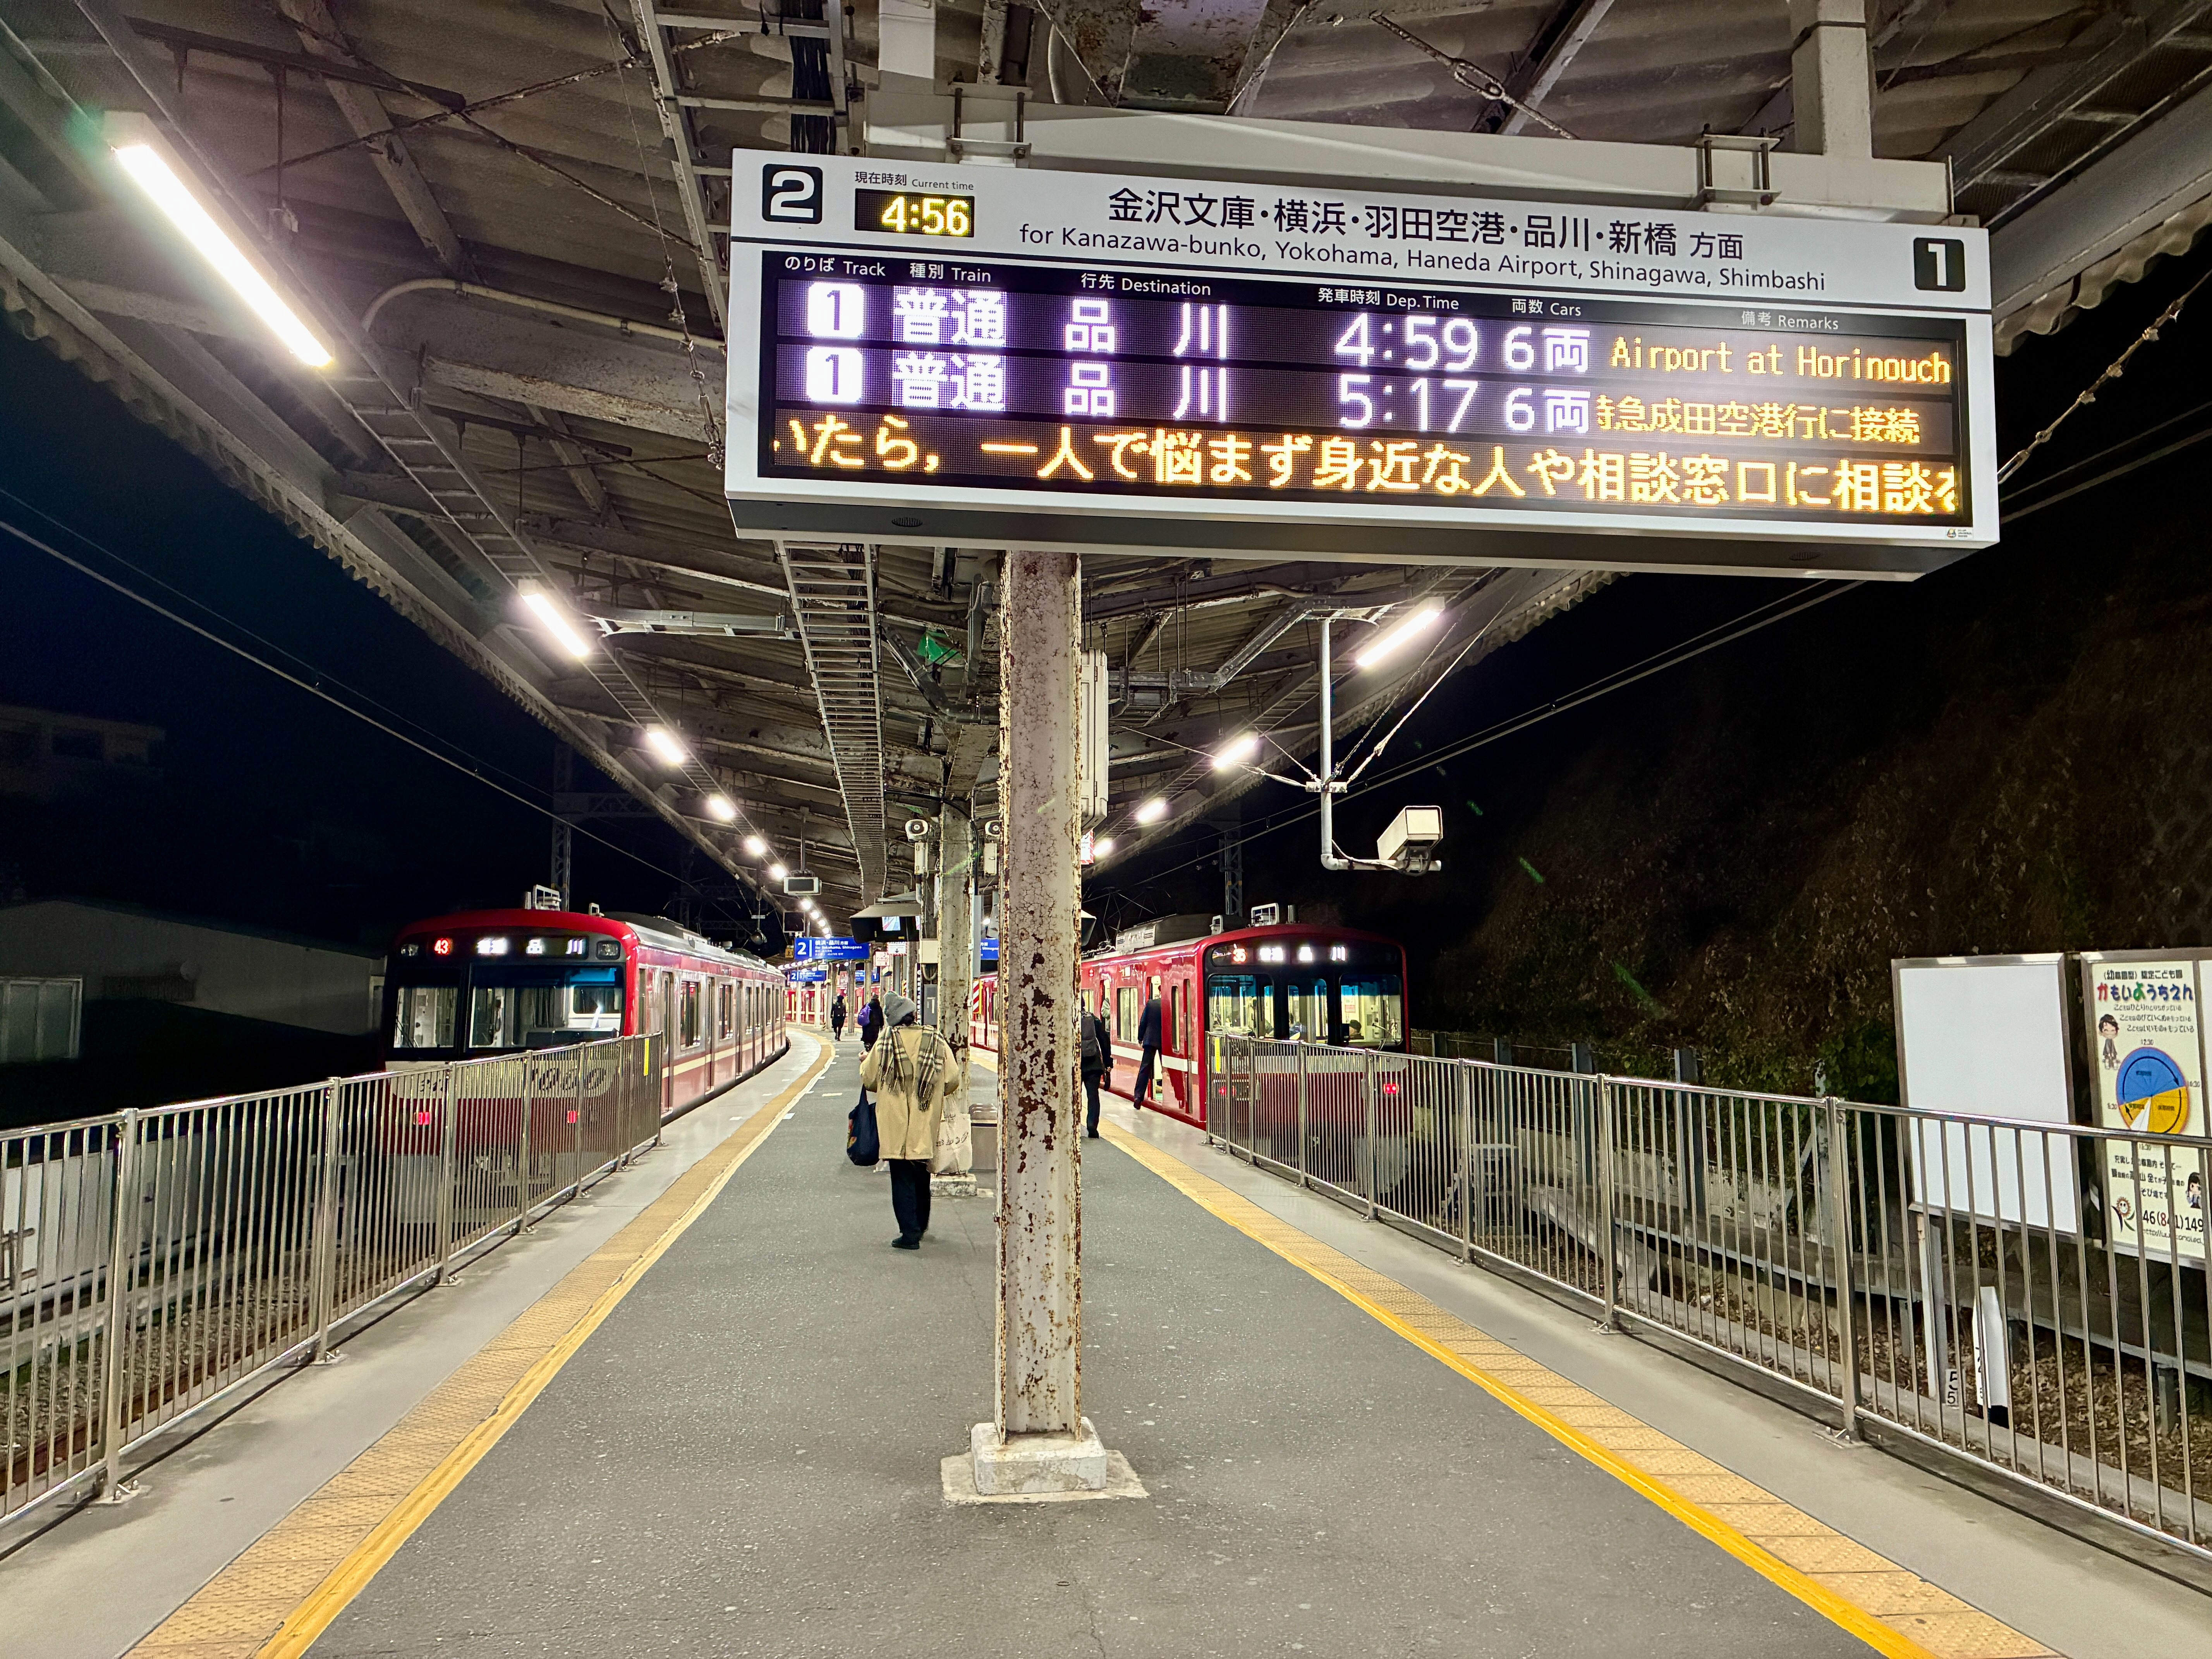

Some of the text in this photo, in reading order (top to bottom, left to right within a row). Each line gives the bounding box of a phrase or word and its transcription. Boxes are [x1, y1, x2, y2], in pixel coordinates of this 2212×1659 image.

[770, 170, 814, 218] 2
[855, 171, 974, 190] 現在時刻 Current time
[882, 196, 969, 237] 4:56
[1019, 224, 1825, 291] for Kanazawa-bunko, Yokohama, Haneda Airport, Shinagawa, Shimbashi
[1689, 232, 1743, 260] 方面
[1927, 243, 1948, 287] 1
[785, 256, 835, 272] のりば
[843, 261, 886, 276] Track
[910, 263, 944, 280] 種別
[951, 267, 991, 283] Train
[1081, 273, 1115, 289] 行先
[1122, 278, 1211, 295] Destination
[1318, 288, 1380, 306] 発車時刻
[1512, 299, 1543, 314] 両数
[1550, 303, 1582, 316] Cars
[1742, 311, 1772, 326] 備考
[1778, 315, 1839, 330] Remarks
[893, 286, 1007, 347] 普通
[1335, 313, 1479, 371] 4:59
[1611, 336, 1733, 373] Airport
[1747, 343, 1784, 375] at
[1797, 345, 1951, 383] Horinouch
[891, 349, 1006, 412] 普通
[1339, 374, 1478, 432] 5:17
[434, 939, 449, 955] 43
[798, 942, 807, 955] 2
[1233, 949, 1246, 962] 35
[2097, 981, 2194, 1001] かもいようちえん
[1947, 1391, 1956, 1404] 5
